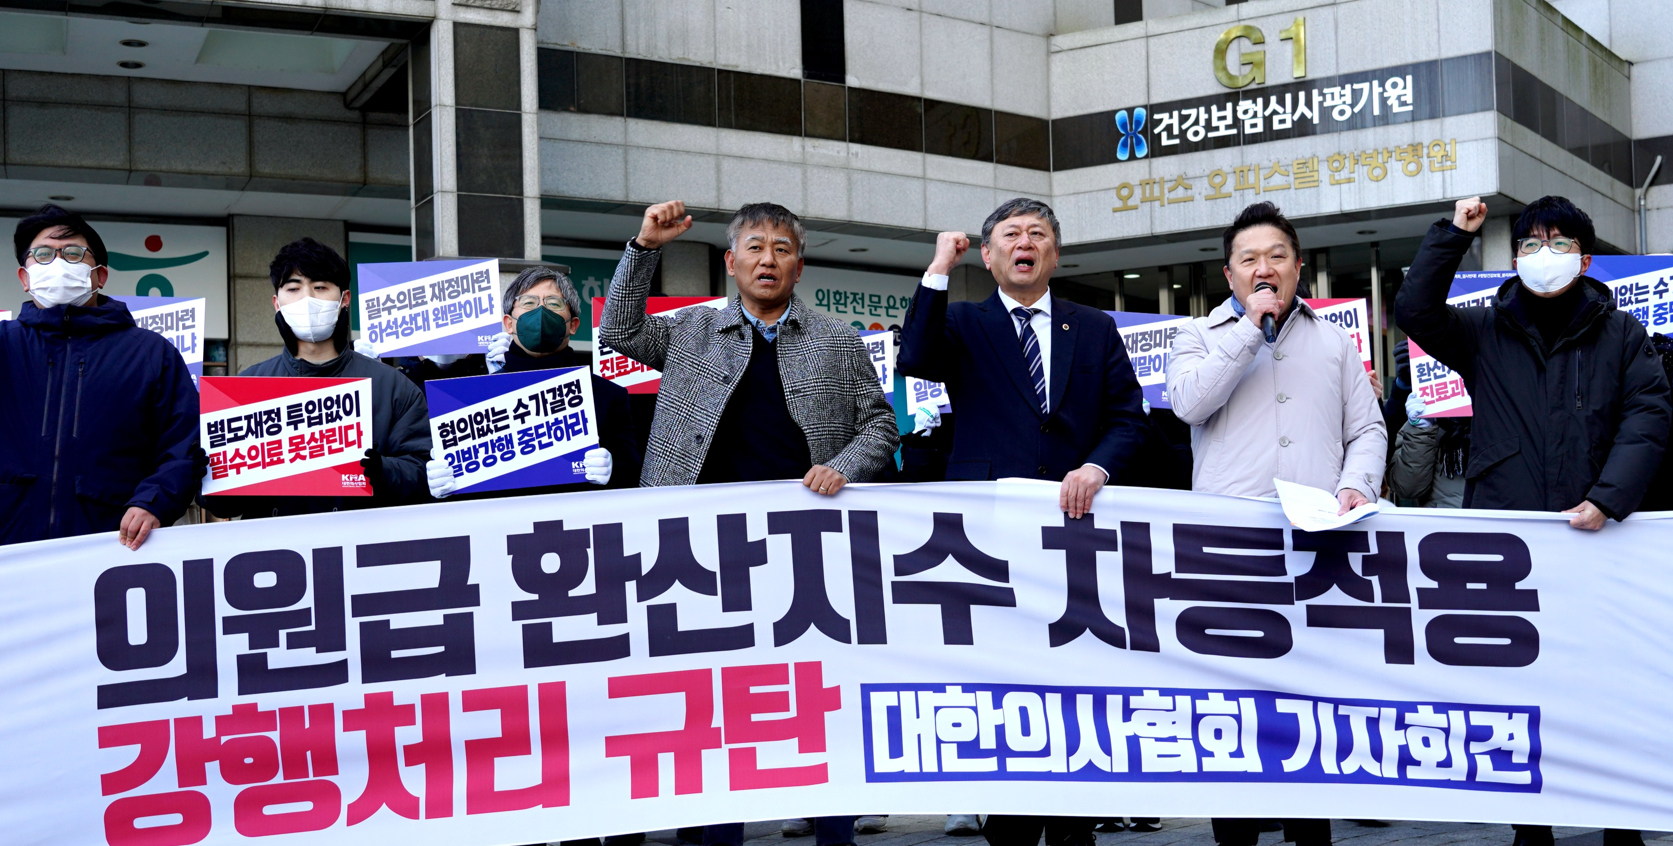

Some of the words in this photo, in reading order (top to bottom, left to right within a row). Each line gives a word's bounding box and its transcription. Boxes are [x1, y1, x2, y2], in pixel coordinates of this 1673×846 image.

[1213, 17, 1307, 89] G1
[1153, 75, 1414, 146] 건강보험심사평가원
[1112, 175, 1194, 212] 오피스
[1205, 157, 1319, 200] 오피스텔
[1327, 139, 1457, 186] 한방병원
[365, 285, 428, 320] 필수의료
[429, 269, 492, 302] 재정마련
[367, 309, 431, 344] 하석상대
[432, 293, 495, 329] 왠말이냐
[207, 407, 282, 449] 별도재정
[286, 390, 361, 431] 투입없이
[437, 406, 510, 450] 협의없는
[513, 378, 584, 425] 수가결정
[1419, 377, 1471, 406] 진료과
[209, 439, 285, 480] 필수의료
[288, 422, 363, 464] 못살린다
[444, 433, 516, 478] 일방강행
[517, 409, 588, 456] 중단하라
[94, 535, 481, 710] 의원급
[506, 509, 1017, 669] 환산지수
[1041, 513, 1541, 668] 차등적용
[97, 681, 571, 846] 강행처리
[605, 661, 842, 800] 규탄
[870, 684, 1262, 775] 대한의사협회
[1280, 698, 1533, 786] 기자회견
